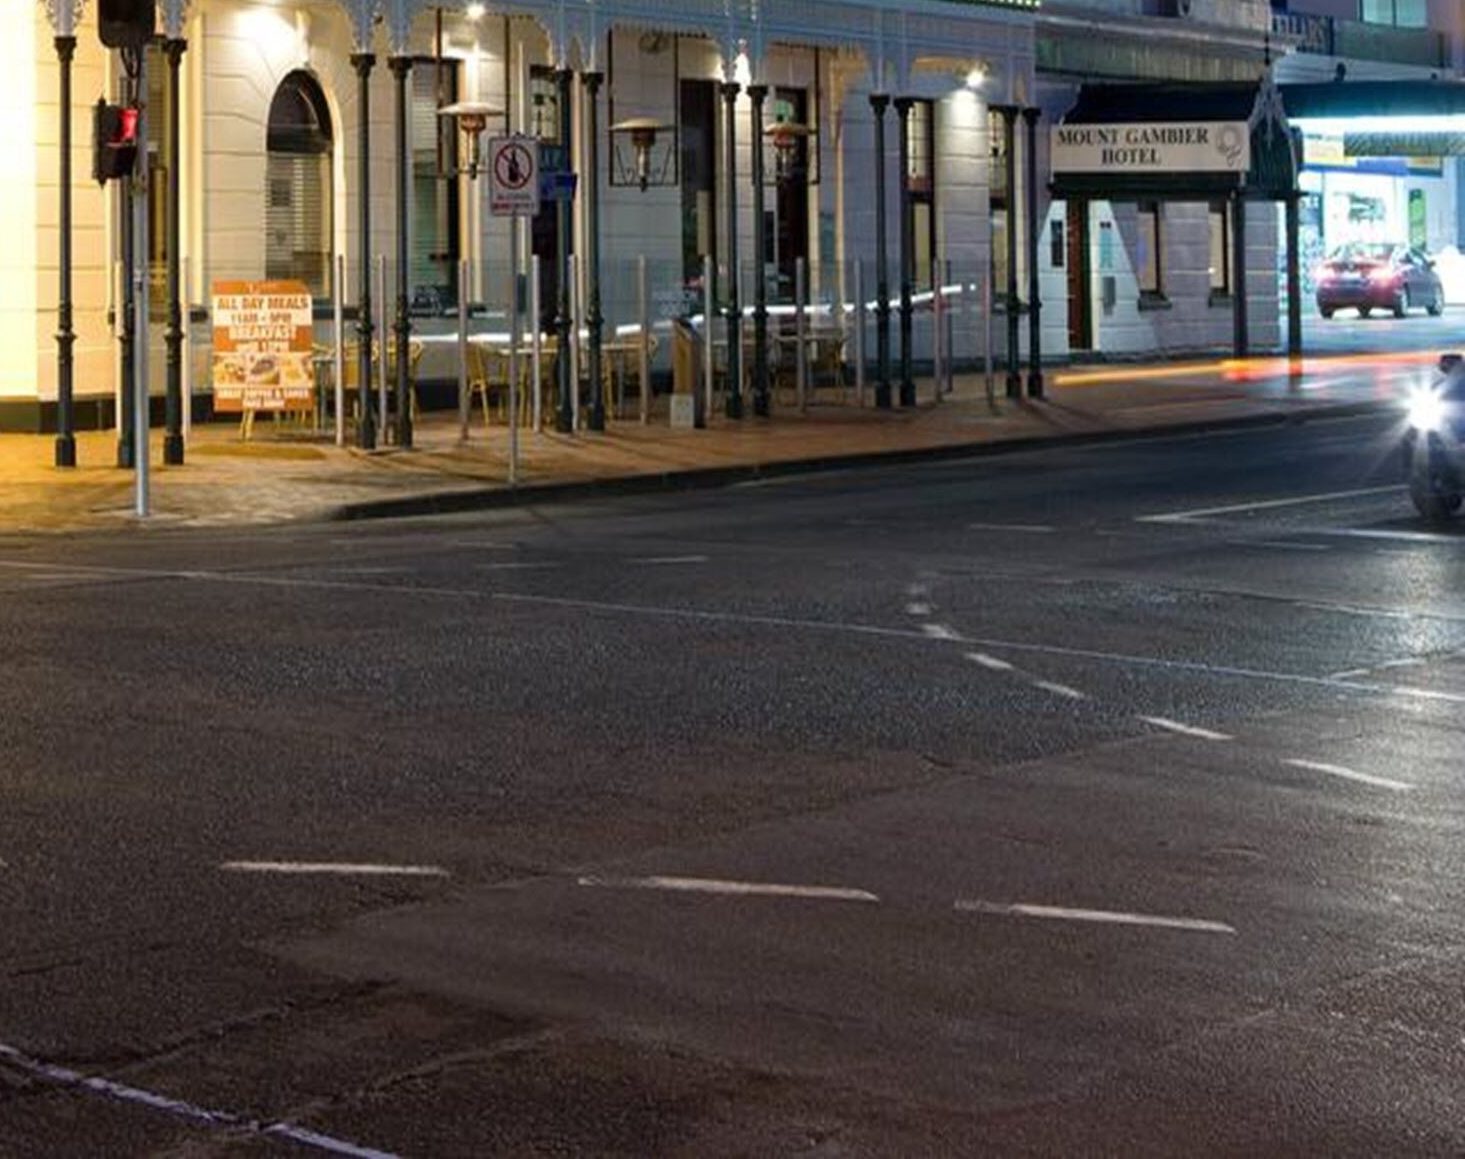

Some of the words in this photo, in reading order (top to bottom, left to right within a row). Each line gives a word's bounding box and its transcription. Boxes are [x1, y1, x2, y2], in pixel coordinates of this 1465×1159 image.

[1057, 128, 1118, 146] MOUNT
[1125, 127, 1209, 145] GAMBIER
[1101, 147, 1161, 165] HOTEL
[217, 298, 238, 310] ALL
[242, 298, 264, 310] DAY
[267, 297, 308, 310] MEALS
[229, 326, 297, 340] BREAKFAST
